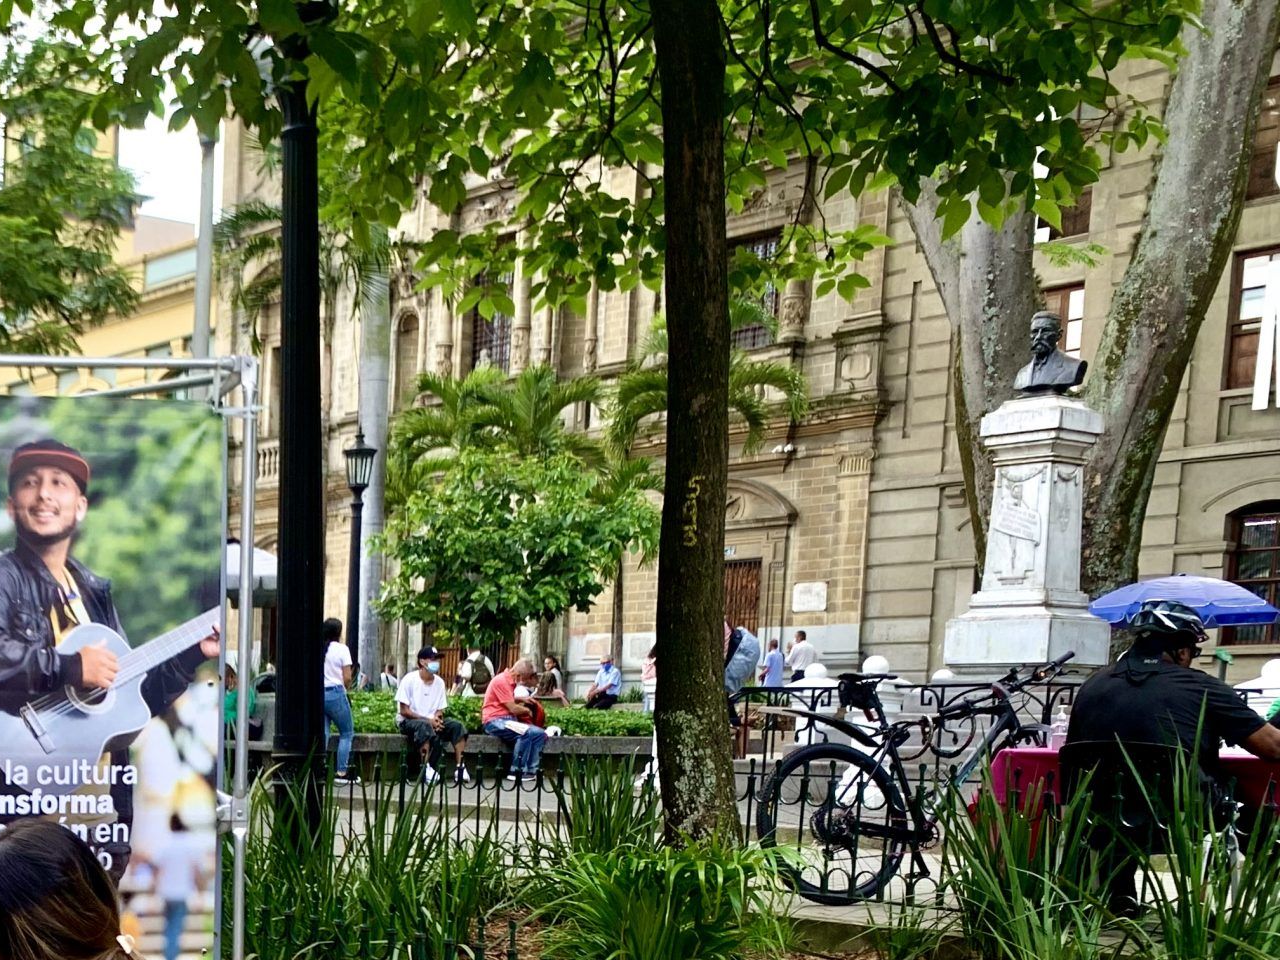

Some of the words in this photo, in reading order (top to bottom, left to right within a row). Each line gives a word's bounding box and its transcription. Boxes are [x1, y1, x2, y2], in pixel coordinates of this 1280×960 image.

[5, 758, 29, 785] la
[36, 758, 138, 785] cultura
[94, 822, 129, 843] en
